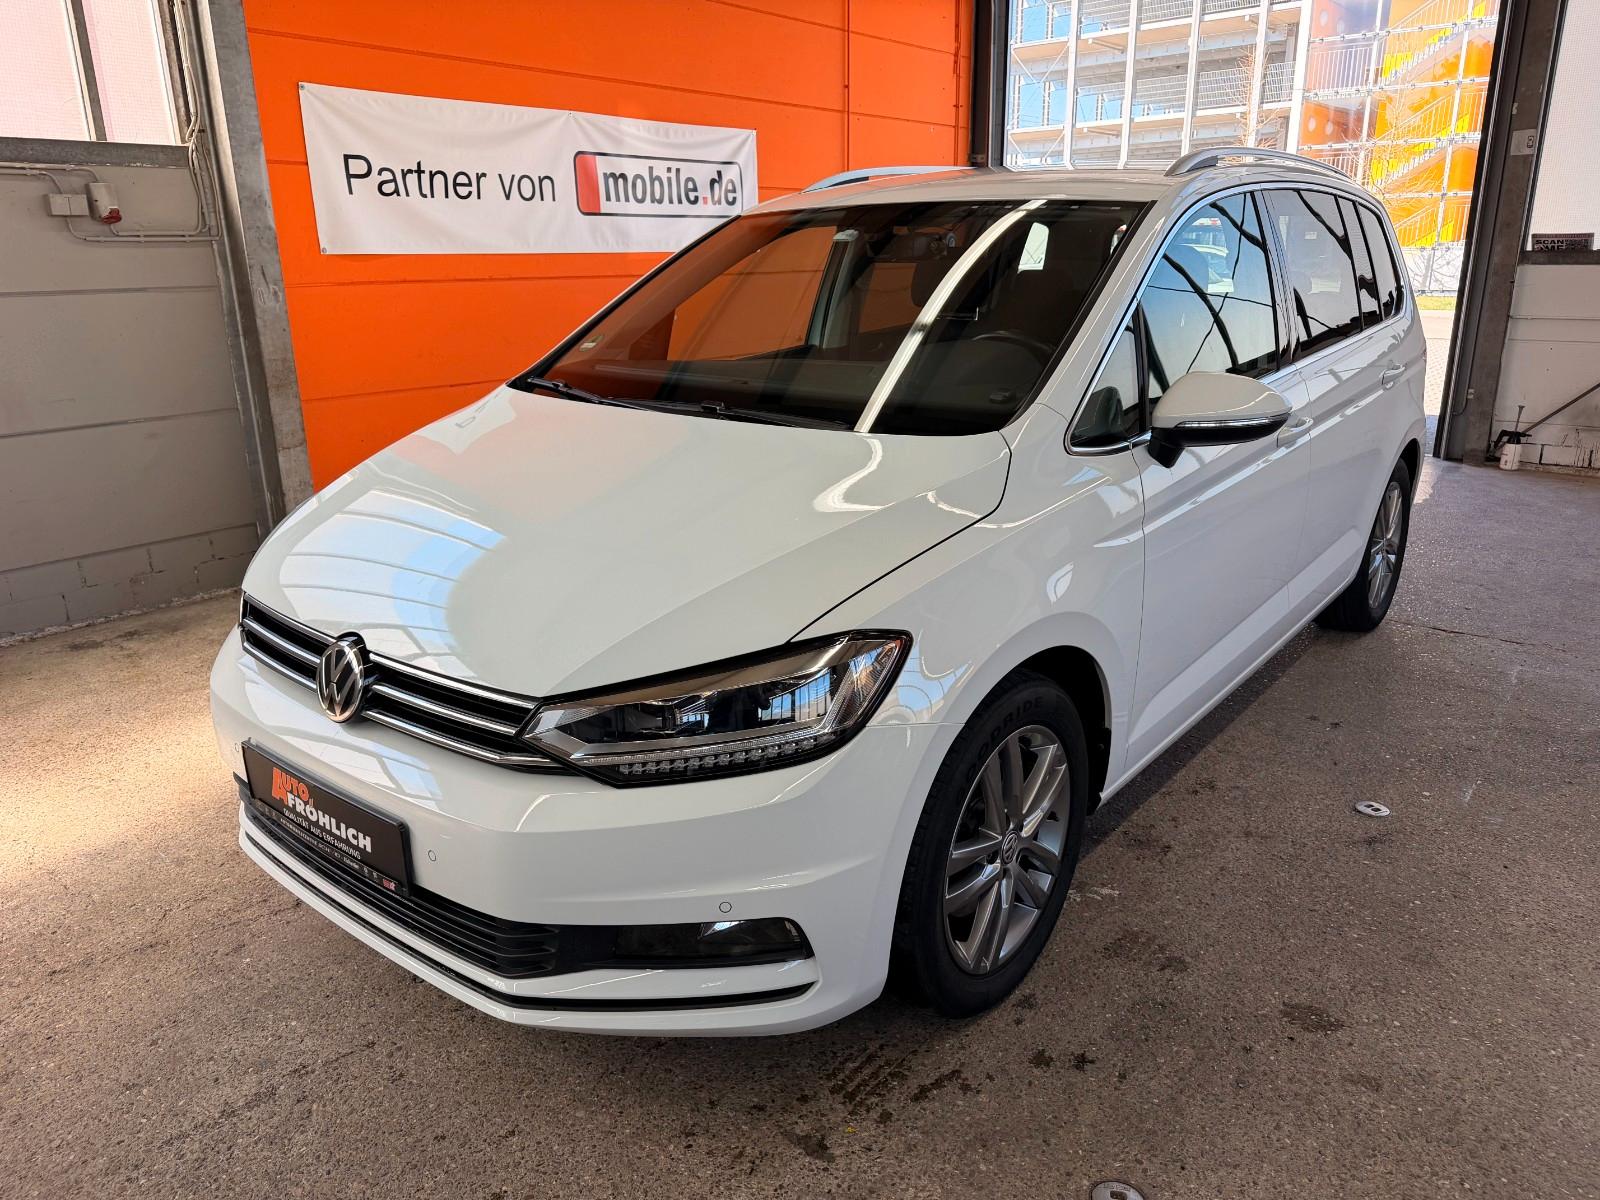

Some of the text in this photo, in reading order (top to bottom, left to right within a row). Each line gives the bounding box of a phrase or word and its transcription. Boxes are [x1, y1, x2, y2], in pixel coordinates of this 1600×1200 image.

[343, 153, 738, 207] Partner von mobile.de
[271, 767, 309, 805] AUTO
[287, 791, 372, 853] FRÖHLICH
